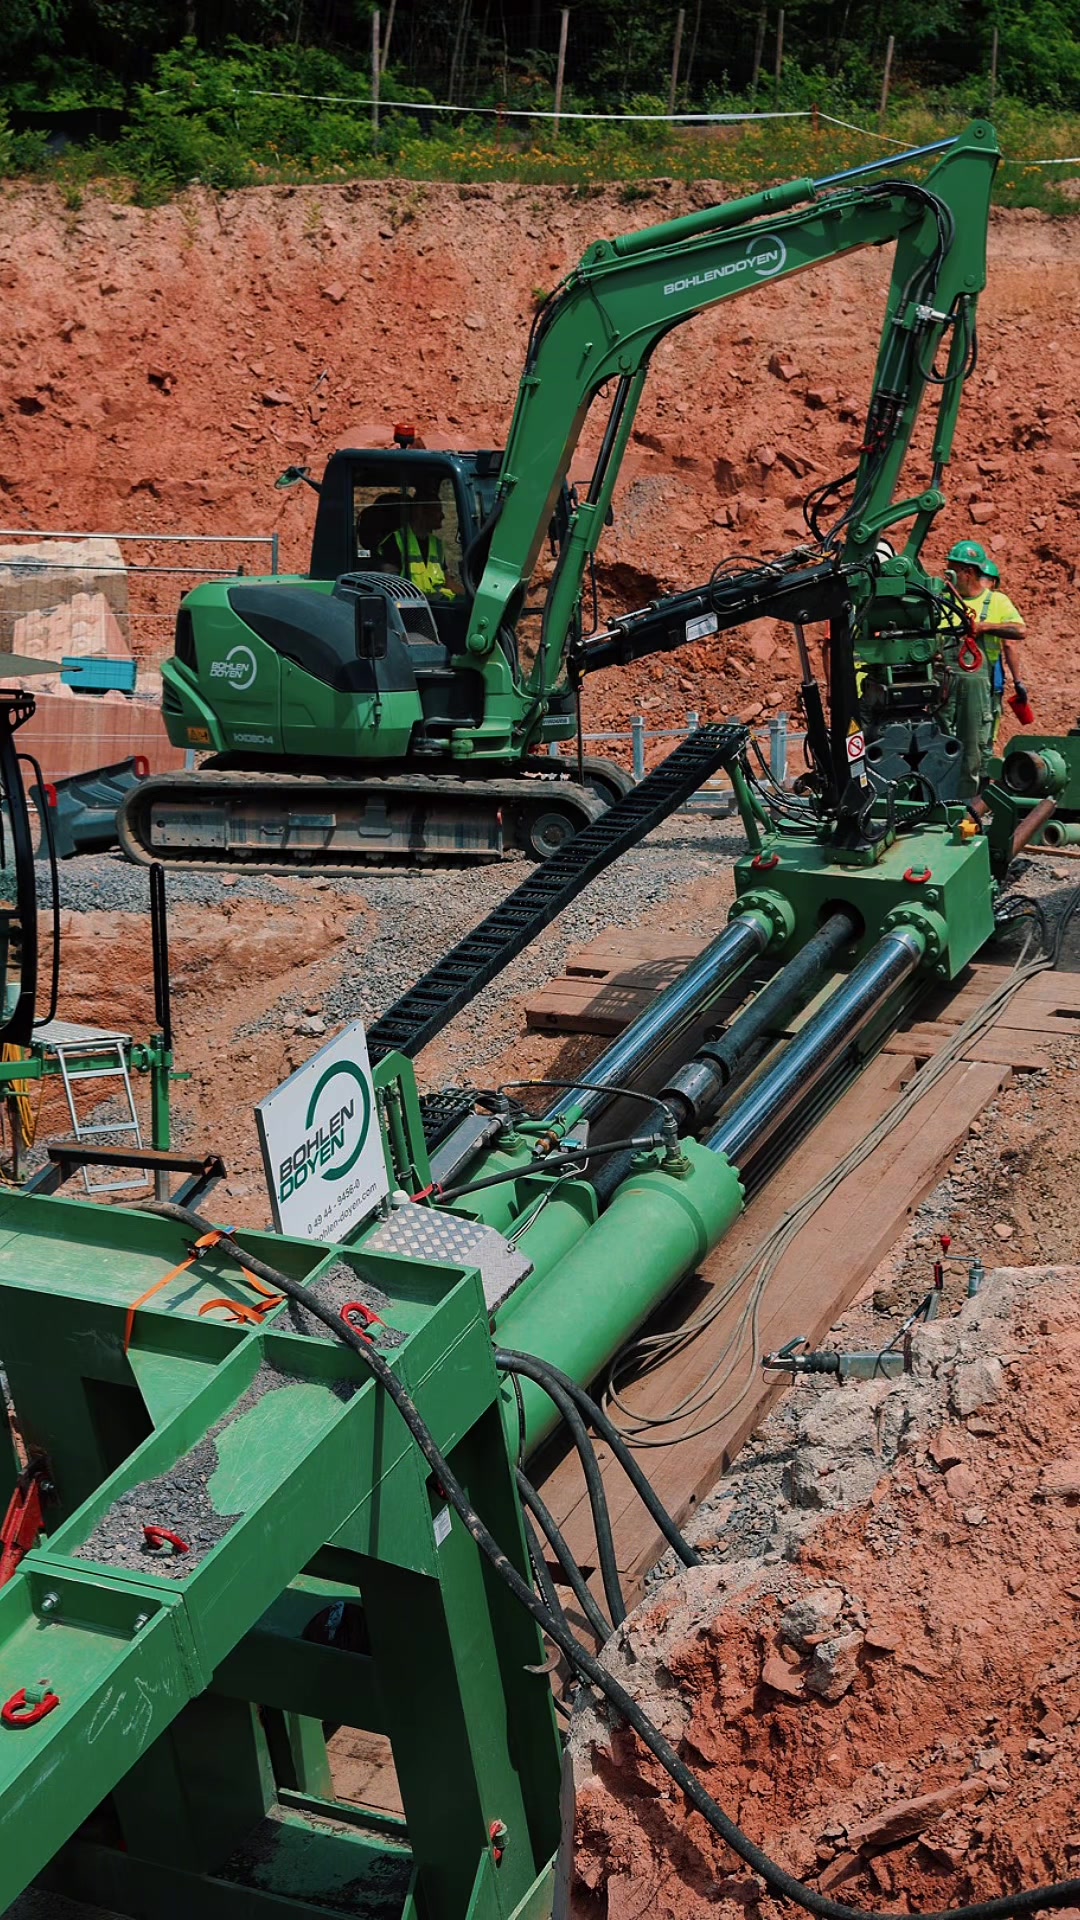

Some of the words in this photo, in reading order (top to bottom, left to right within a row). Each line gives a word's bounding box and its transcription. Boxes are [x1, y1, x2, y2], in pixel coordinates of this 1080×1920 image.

[663, 250, 778, 295] BOHLENDOYEN
[210, 669, 243, 678] DOYEN
[212, 661, 249, 671] BOHLEN
[280, 1099, 354, 1181] BOHLEN
[280, 1128, 345, 1204] DOYEN
